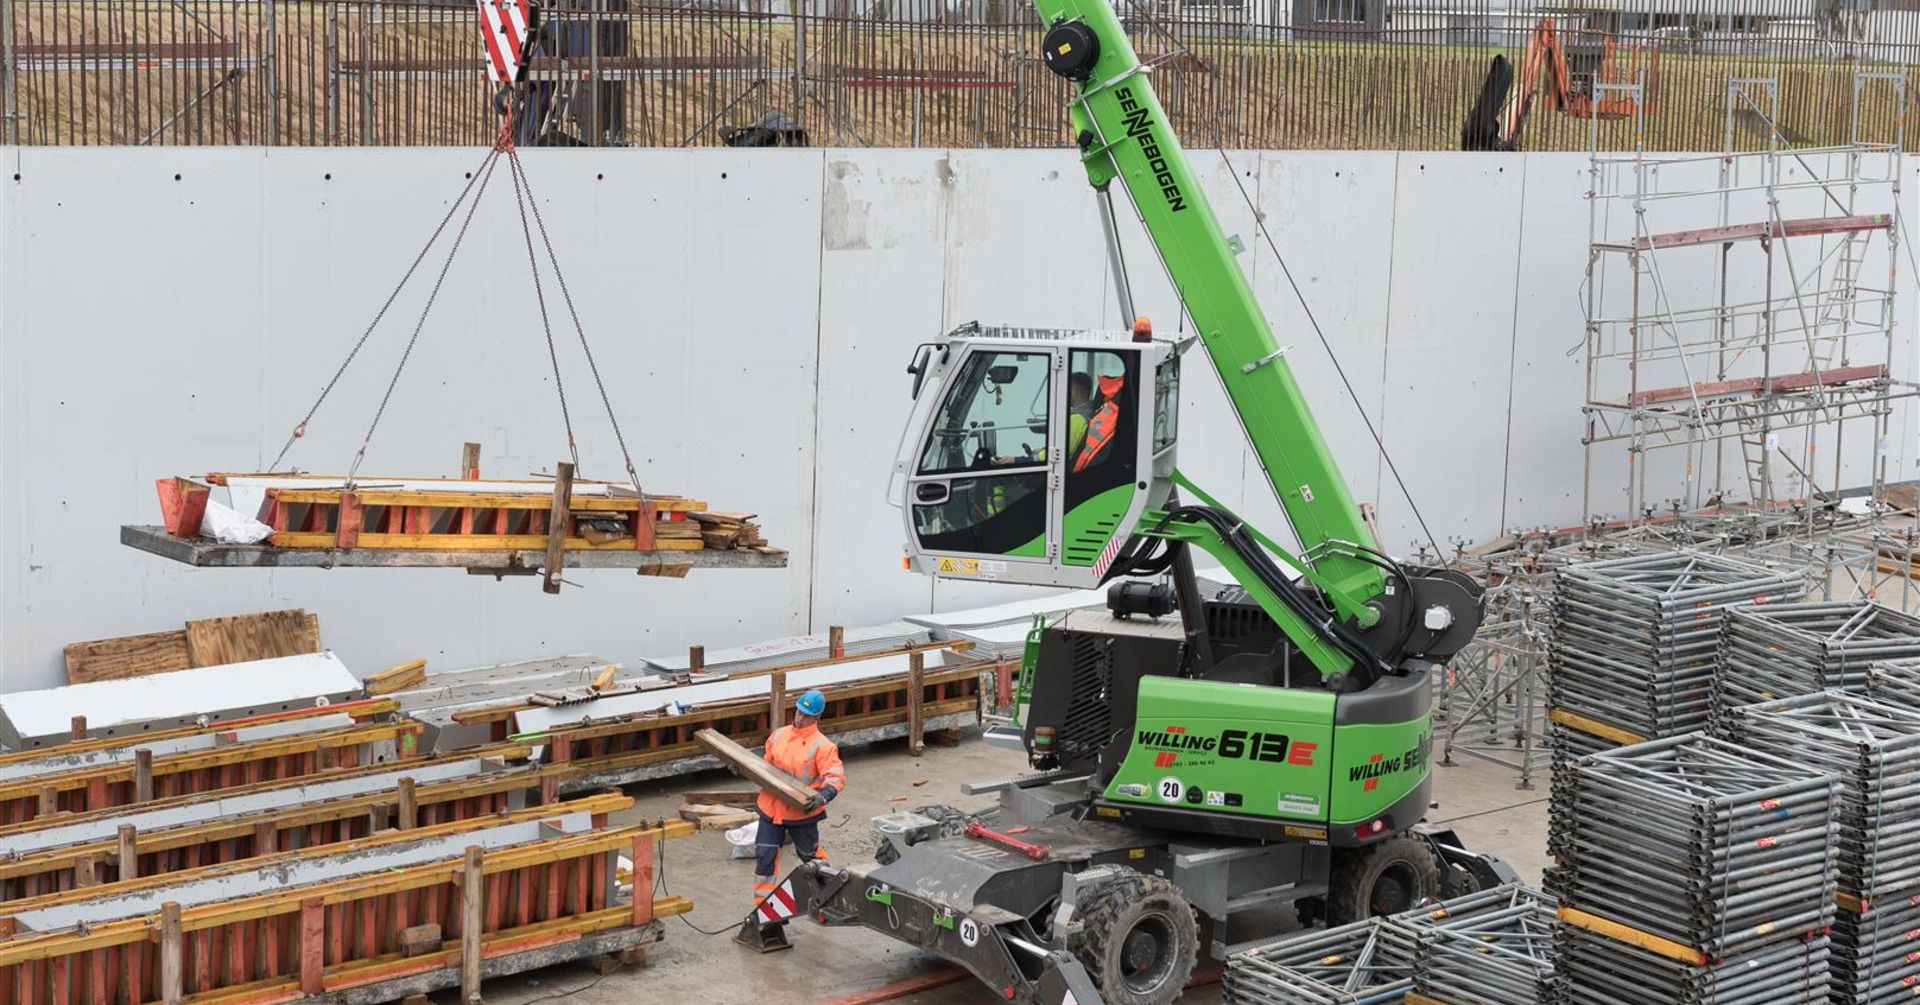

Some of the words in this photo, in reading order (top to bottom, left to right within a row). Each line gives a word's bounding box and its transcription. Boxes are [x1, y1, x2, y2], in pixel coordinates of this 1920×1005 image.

[1114, 87, 1187, 212] SENNEBOGEN
[1138, 731, 1217, 751] WILLING
[1349, 757, 1400, 782] WILLING
[1163, 782, 1179, 798] 20
[963, 923, 976, 942] 20
